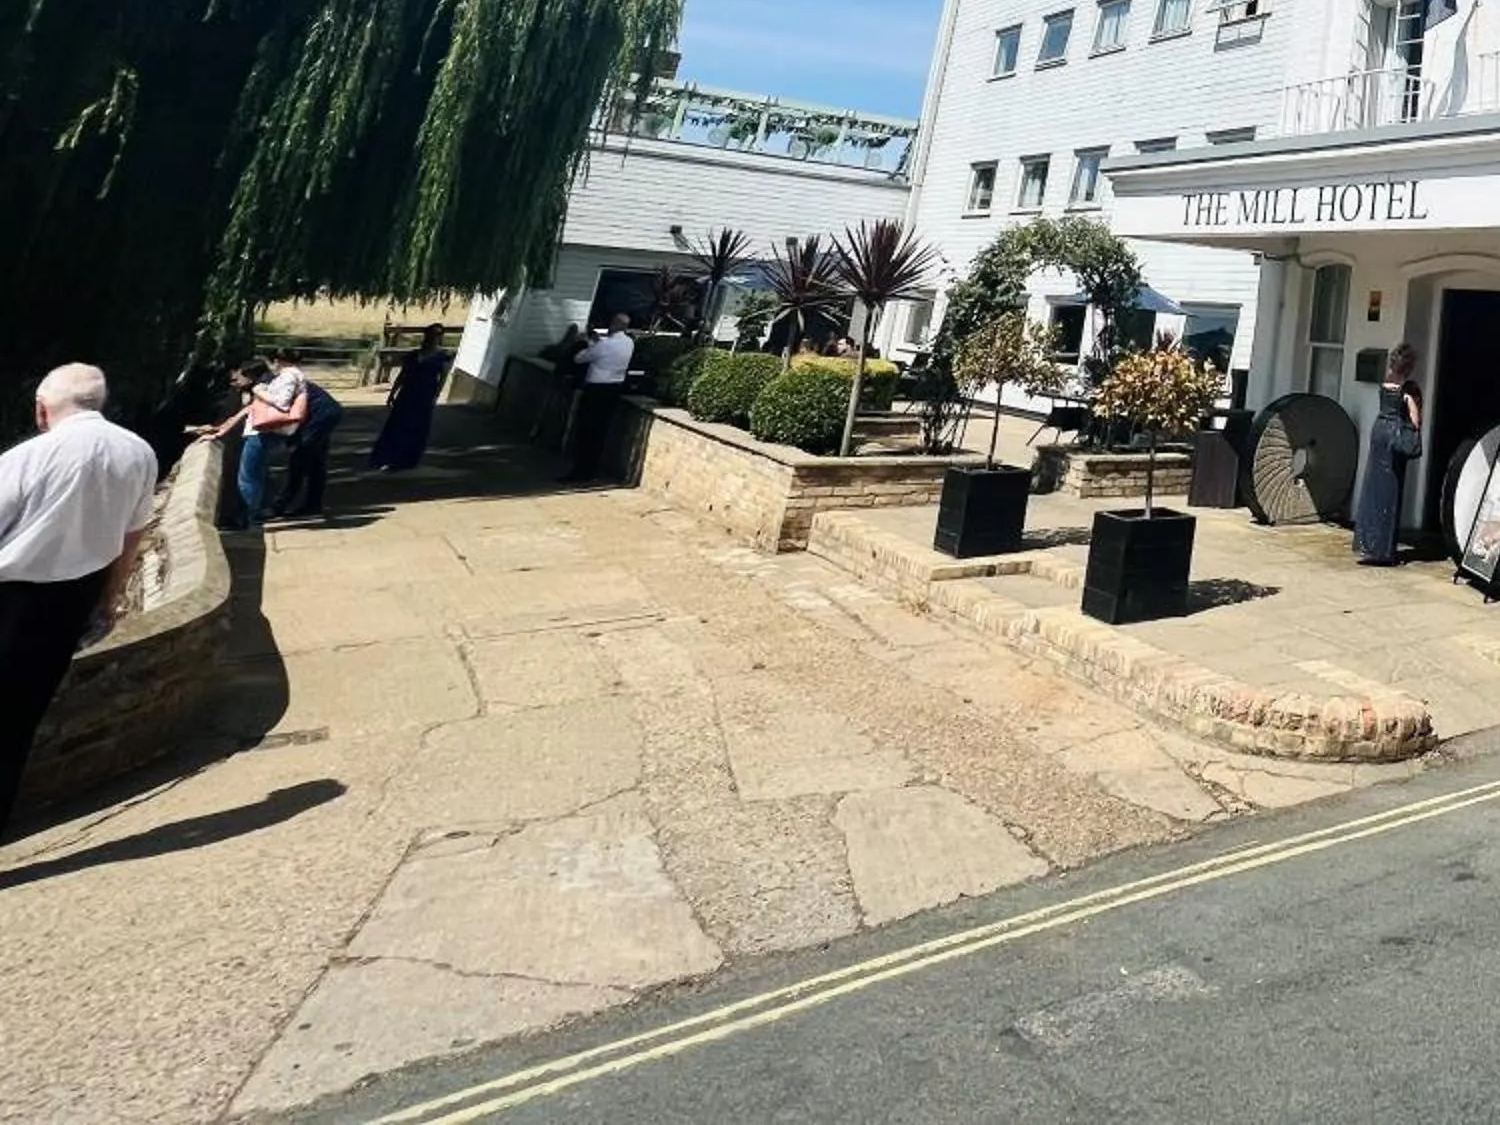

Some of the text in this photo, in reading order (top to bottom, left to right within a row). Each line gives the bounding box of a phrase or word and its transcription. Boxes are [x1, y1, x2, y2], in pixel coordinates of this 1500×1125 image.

[1182, 180, 1428, 225] THE MILL HOTEL
